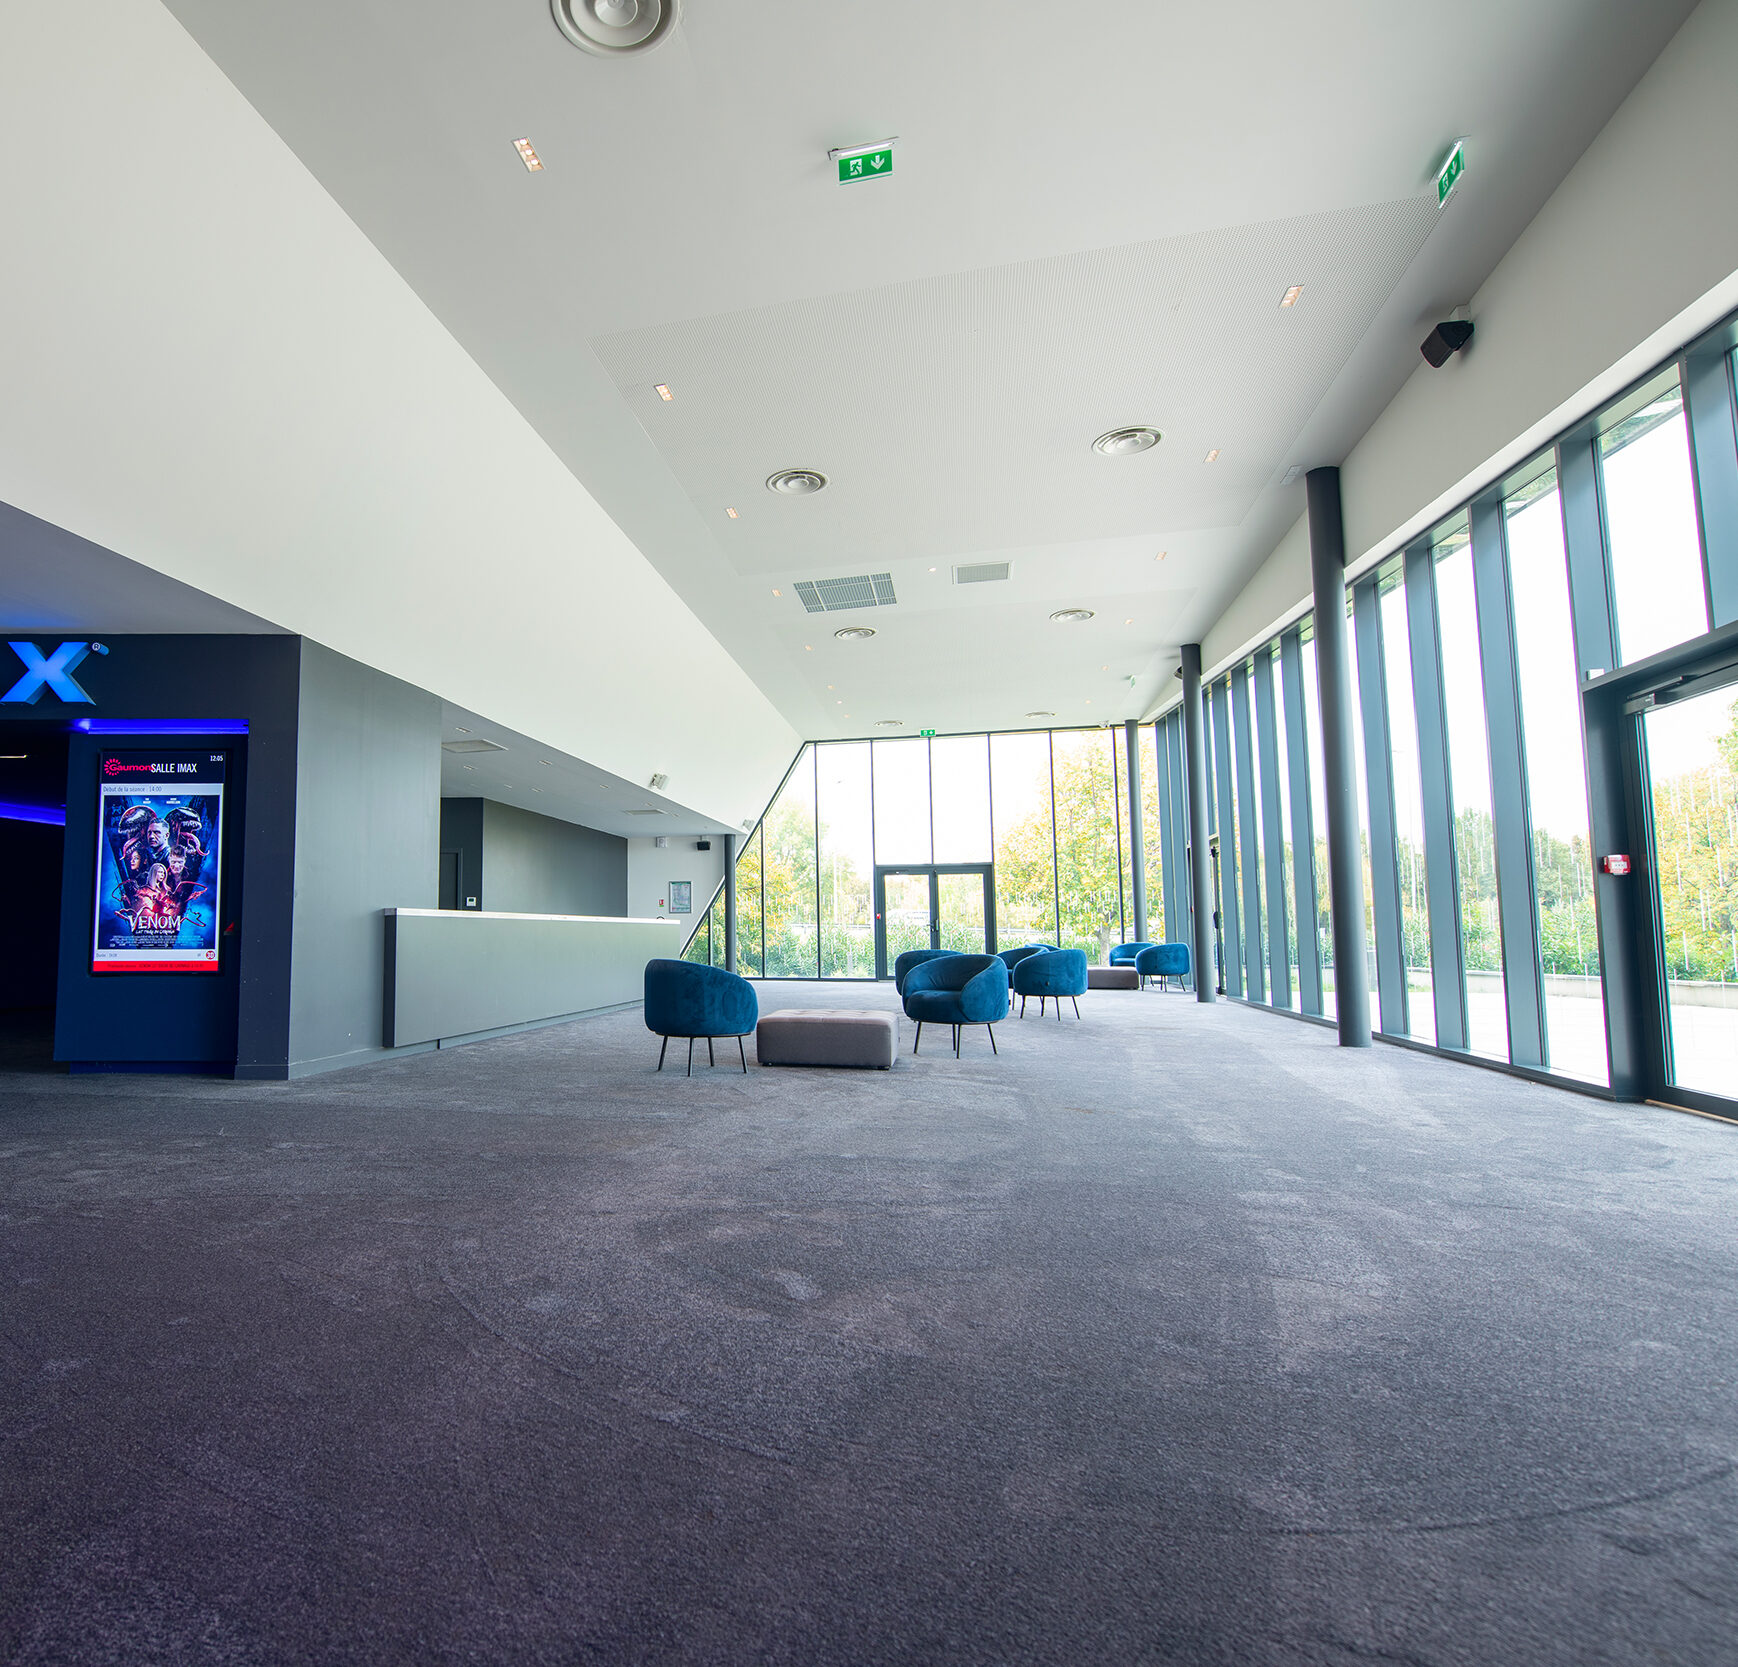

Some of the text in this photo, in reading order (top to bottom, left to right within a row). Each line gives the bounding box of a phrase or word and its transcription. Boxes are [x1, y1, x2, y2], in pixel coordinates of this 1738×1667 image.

[150, 764, 175, 773] SALLE
[177, 764, 197, 773] IMAX
[128, 912, 181, 932] VENOM
